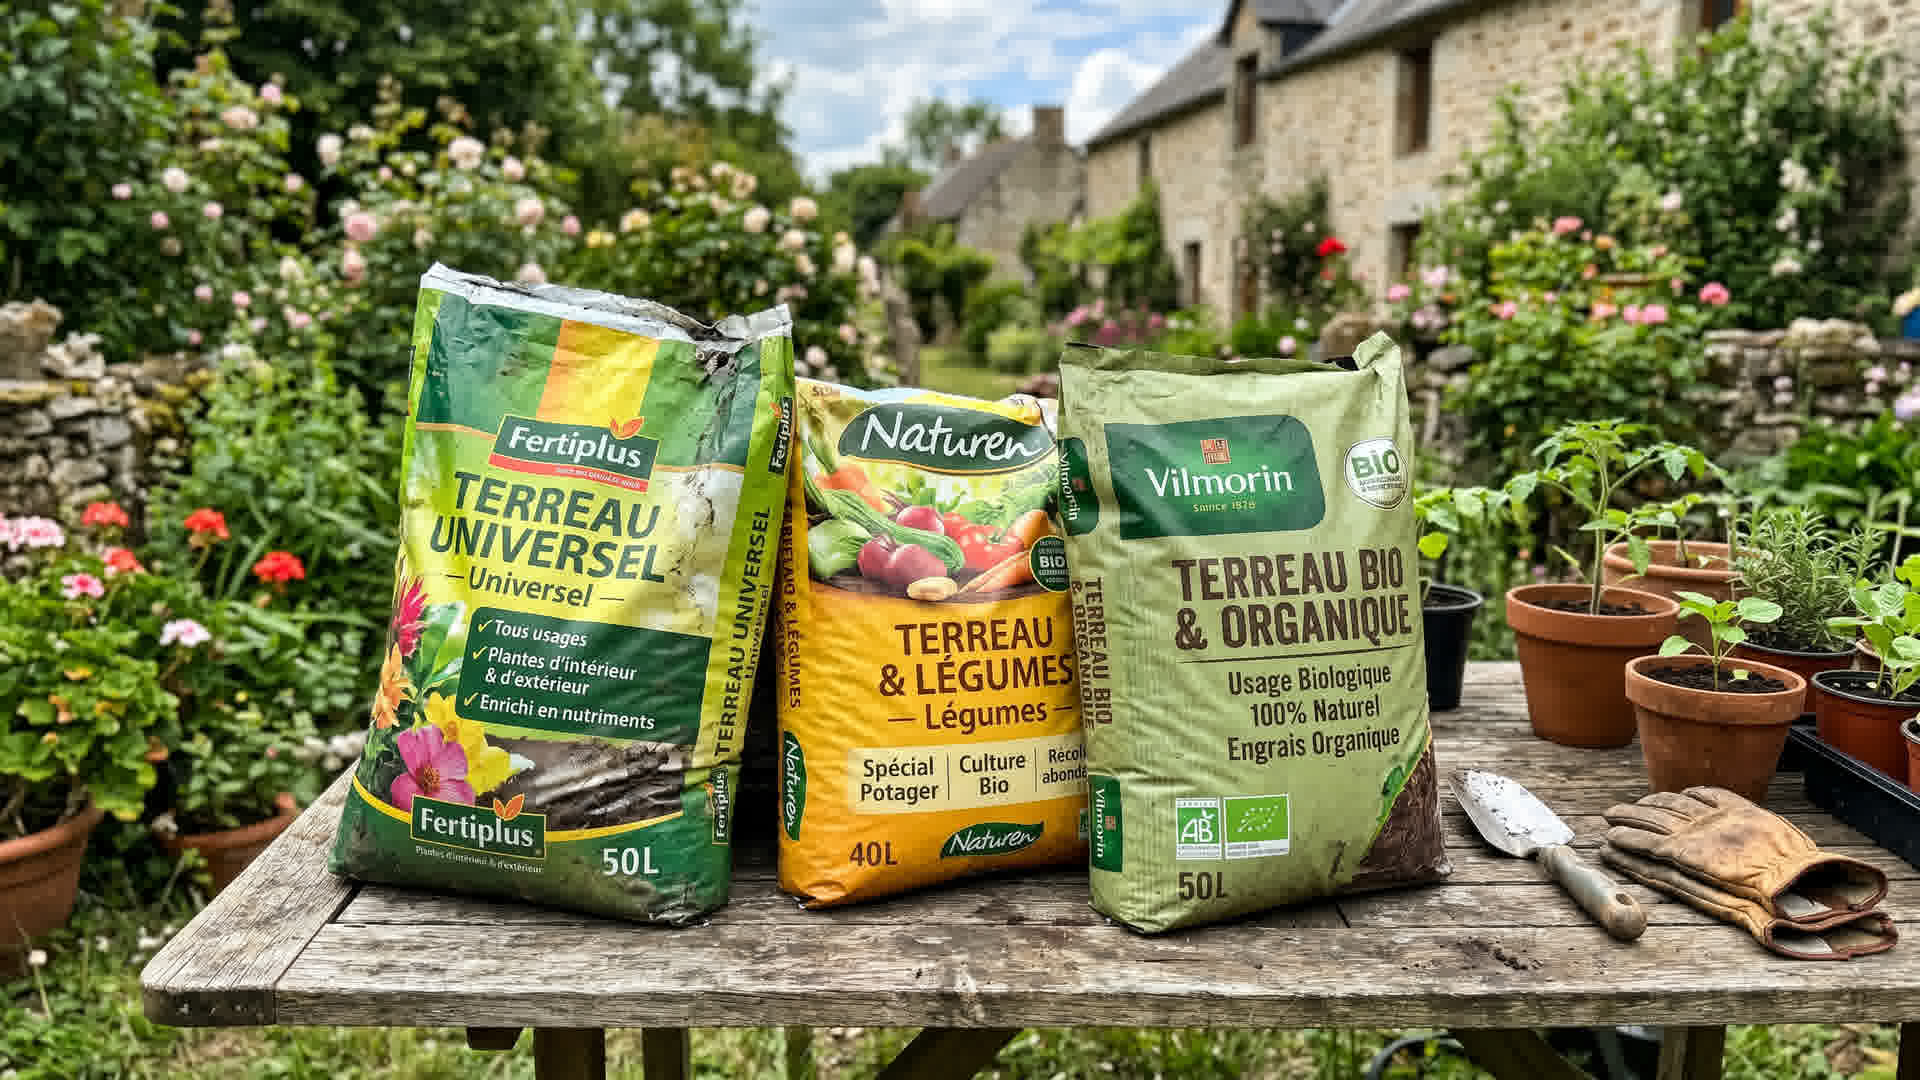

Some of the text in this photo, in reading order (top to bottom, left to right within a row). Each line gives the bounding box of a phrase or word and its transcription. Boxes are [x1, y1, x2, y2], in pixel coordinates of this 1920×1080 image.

[509, 425, 641, 468] Fertiplus
[861, 411, 1043, 461] Naturen
[1060, 452, 1081, 521] Vilmorin
[1143, 464, 1294, 497] Vilmorin
[454, 471, 660, 540] TERREAU
[430, 515, 665, 583] UNIVERSEL
[1039, 555, 1066, 568] BIO
[469, 566, 593, 607] Universel
[1172, 547, 1404, 601] TERREAU BIO
[495, 619, 588, 649] Tous usages
[715, 505, 770, 757] TERREAU UNIVERSEL
[895, 616, 1053, 656] TERREAU
[1175, 594, 1412, 650] & ORGANIQUE
[488, 647, 638, 681] Plantes d'intérieur
[1074, 604, 1095, 729] ORGANIQUE
[1085, 577, 1112, 724] TERREAU BIO
[485, 667, 497, 683] &
[879, 654, 1074, 697] & LÉGUMES
[1228, 664, 1391, 697] Usage Biologique
[480, 694, 656, 730] Enrichi en nutriments
[926, 701, 1048, 735] Légumes
[1250, 694, 1380, 728] 100% Naturel
[959, 752, 1026, 774] Culture
[1228, 727, 1400, 765] Engrais Organique
[863, 756, 934, 783] Spécial
[979, 776, 1009, 796] Bio
[860, 783, 939, 805] Potager
[420, 807, 534, 849] Fertiplus
[1096, 788, 1106, 858] Vilmorin
[1181, 817, 1214, 843] AB
[849, 840, 898, 867] 40L
[949, 828, 1036, 854] Naturen
[602, 846, 659, 876] 50L
[1178, 870, 1227, 901] 50L
